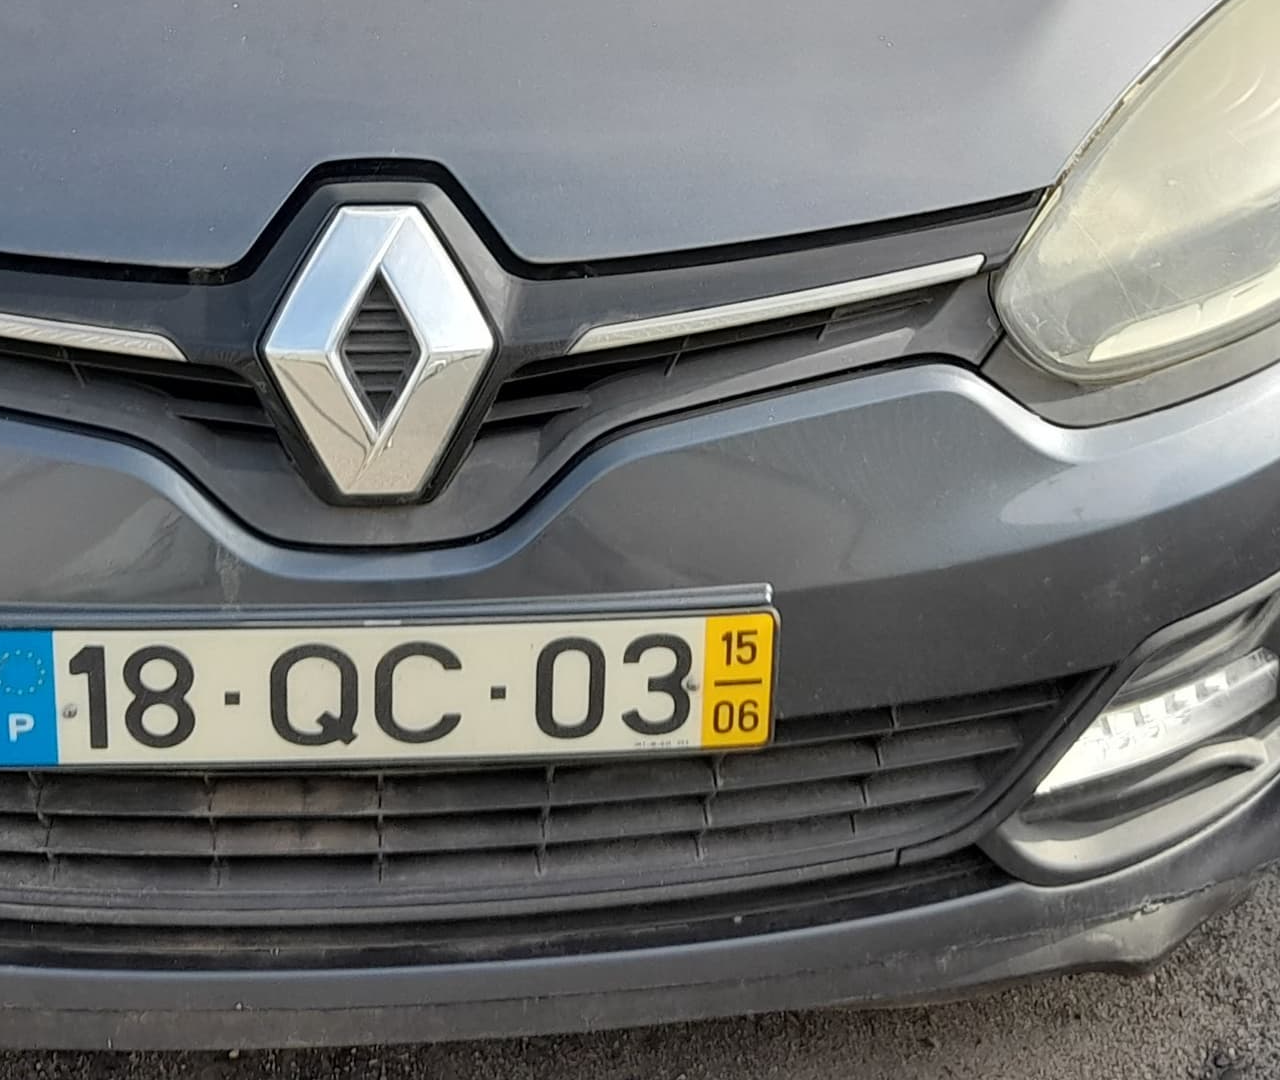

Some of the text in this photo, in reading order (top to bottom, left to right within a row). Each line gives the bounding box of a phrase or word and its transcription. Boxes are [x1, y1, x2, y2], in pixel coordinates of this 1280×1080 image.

[721, 630, 758, 666] 15
[8, 713, 35, 742] P
[713, 699, 759, 734] 06
